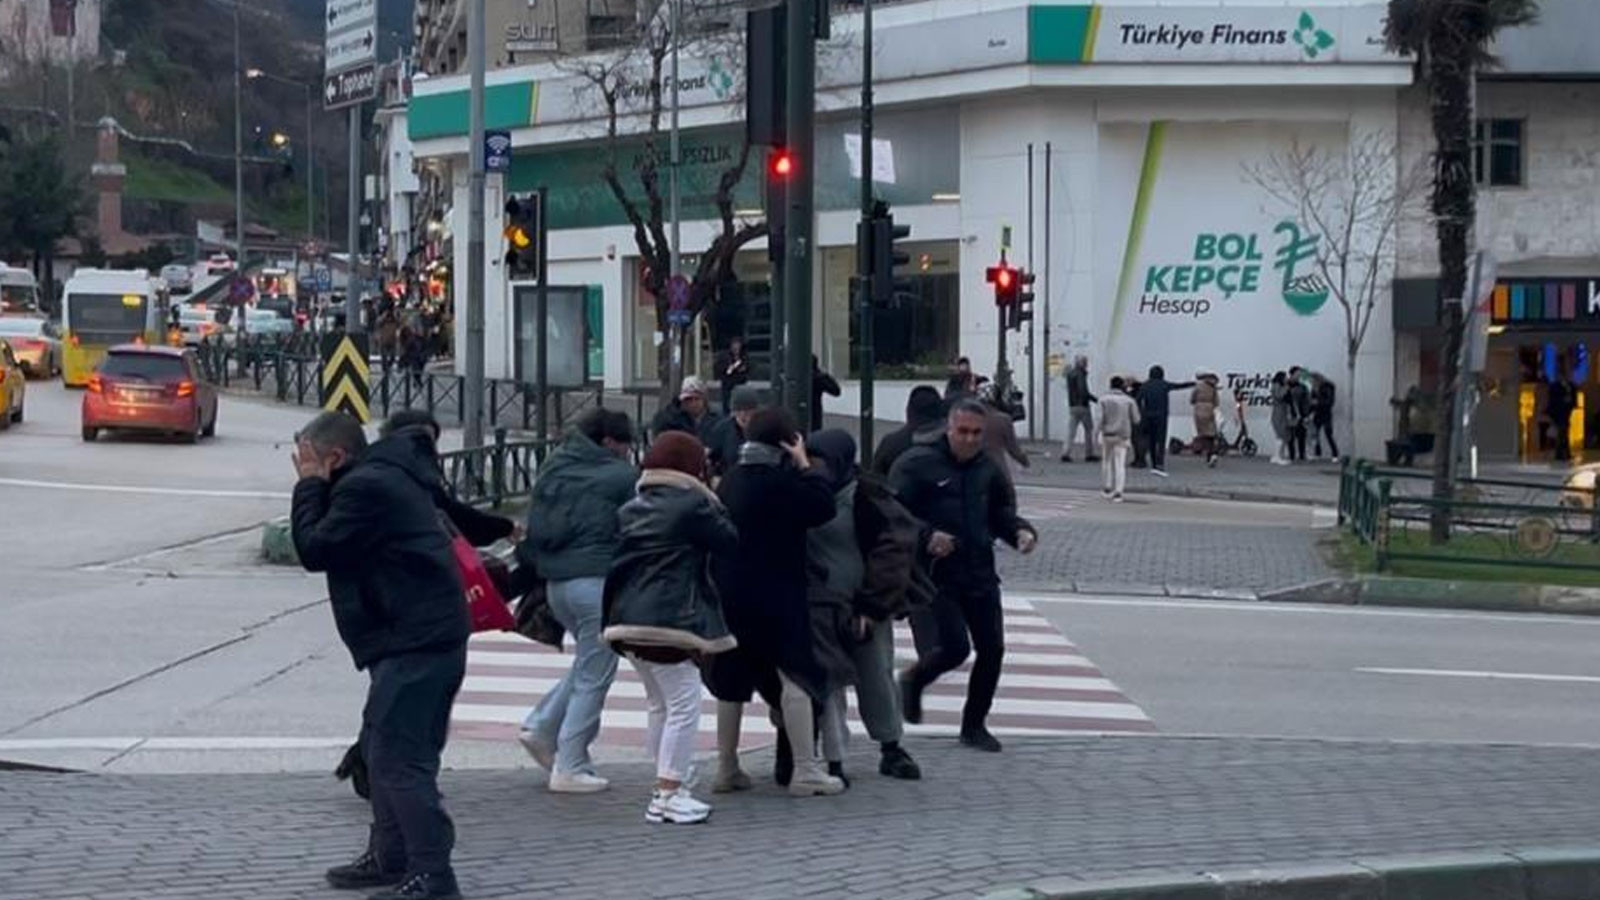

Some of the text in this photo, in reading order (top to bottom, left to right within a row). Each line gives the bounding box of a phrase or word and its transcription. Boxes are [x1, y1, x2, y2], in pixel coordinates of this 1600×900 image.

[1120, 24, 1287, 50] Türkiye Finans
[662, 76, 706, 92] Fans
[1193, 233, 1263, 261] BOL
[1144, 265, 1261, 299] KEPÇE
[1139, 295, 1211, 318] Hesap
[1227, 372, 1270, 388] Türki
